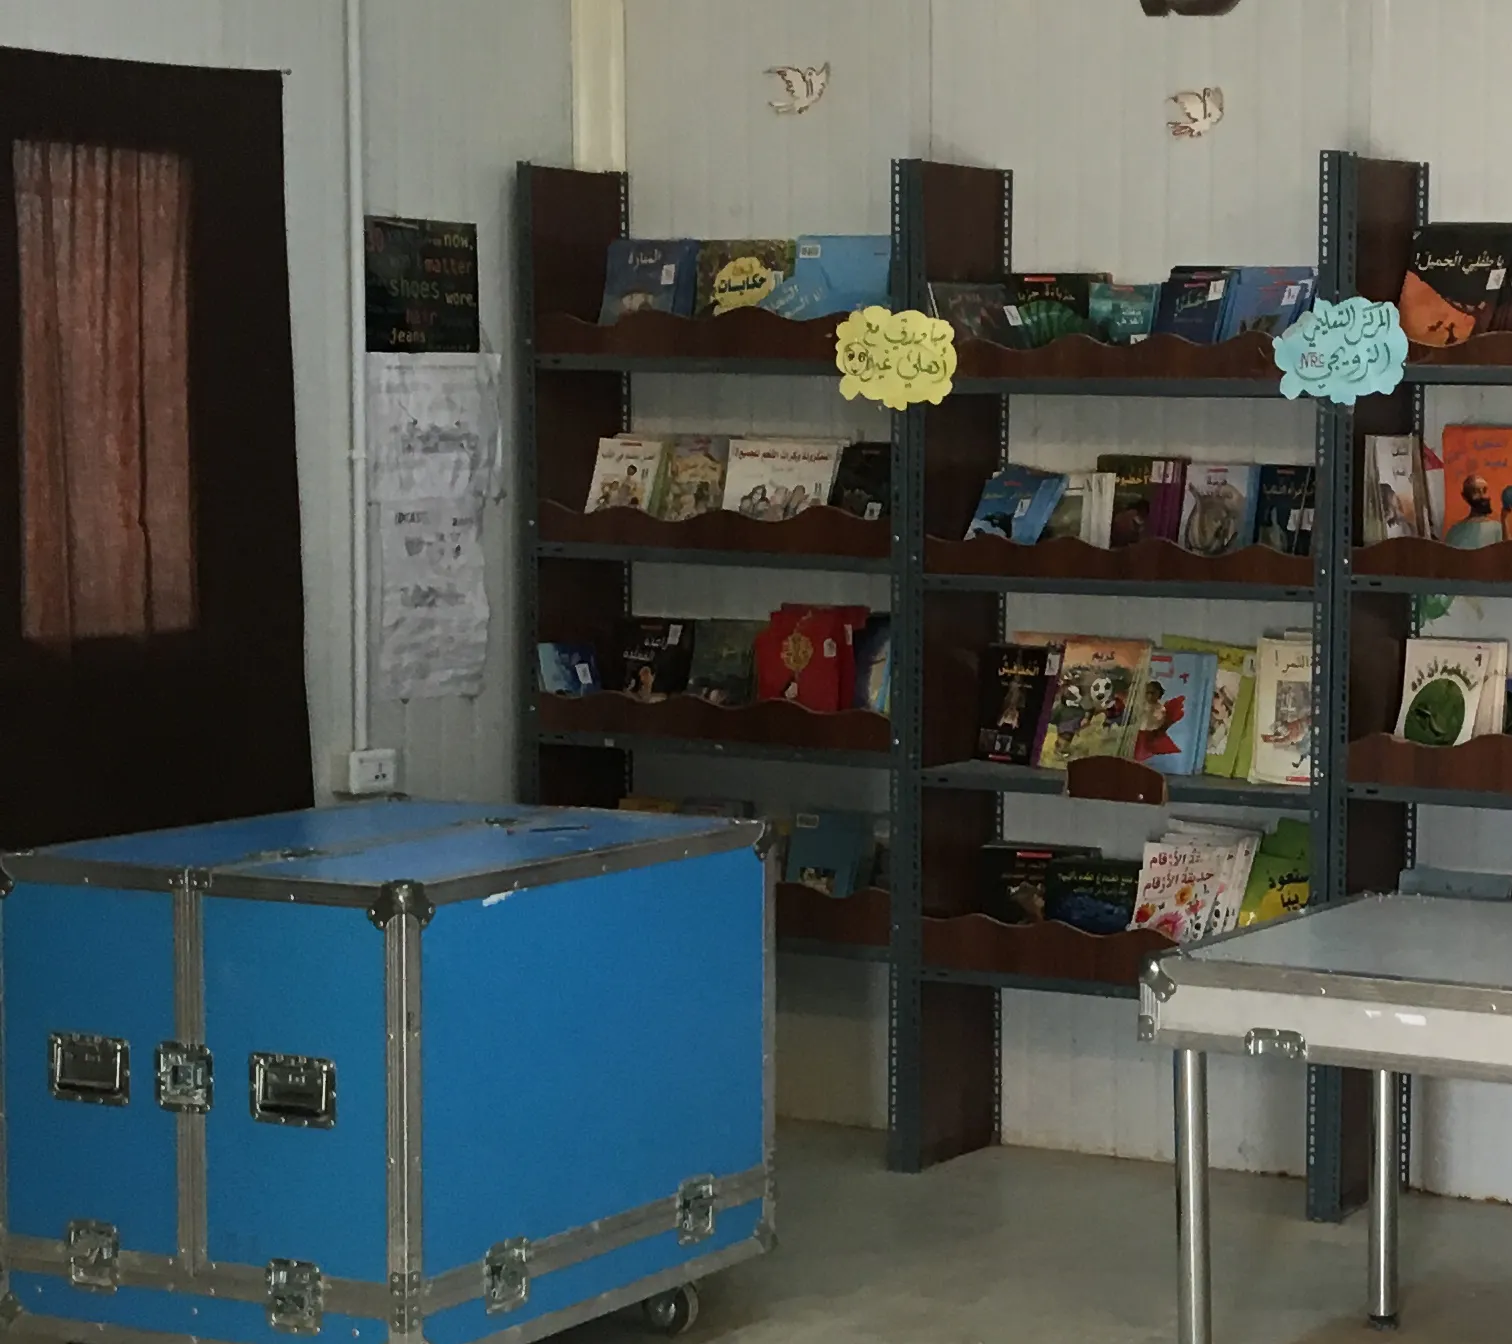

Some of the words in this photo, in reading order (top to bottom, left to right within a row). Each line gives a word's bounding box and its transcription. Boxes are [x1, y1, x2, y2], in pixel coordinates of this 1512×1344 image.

[424, 256, 473, 277] matter
[389, 274, 441, 301] shoes
[388, 327, 427, 346] jeans
[1091, 650, 1117, 664] كريم
[1143, 868, 1181, 896] الأرقام
[1182, 866, 1214, 887] حديقة
